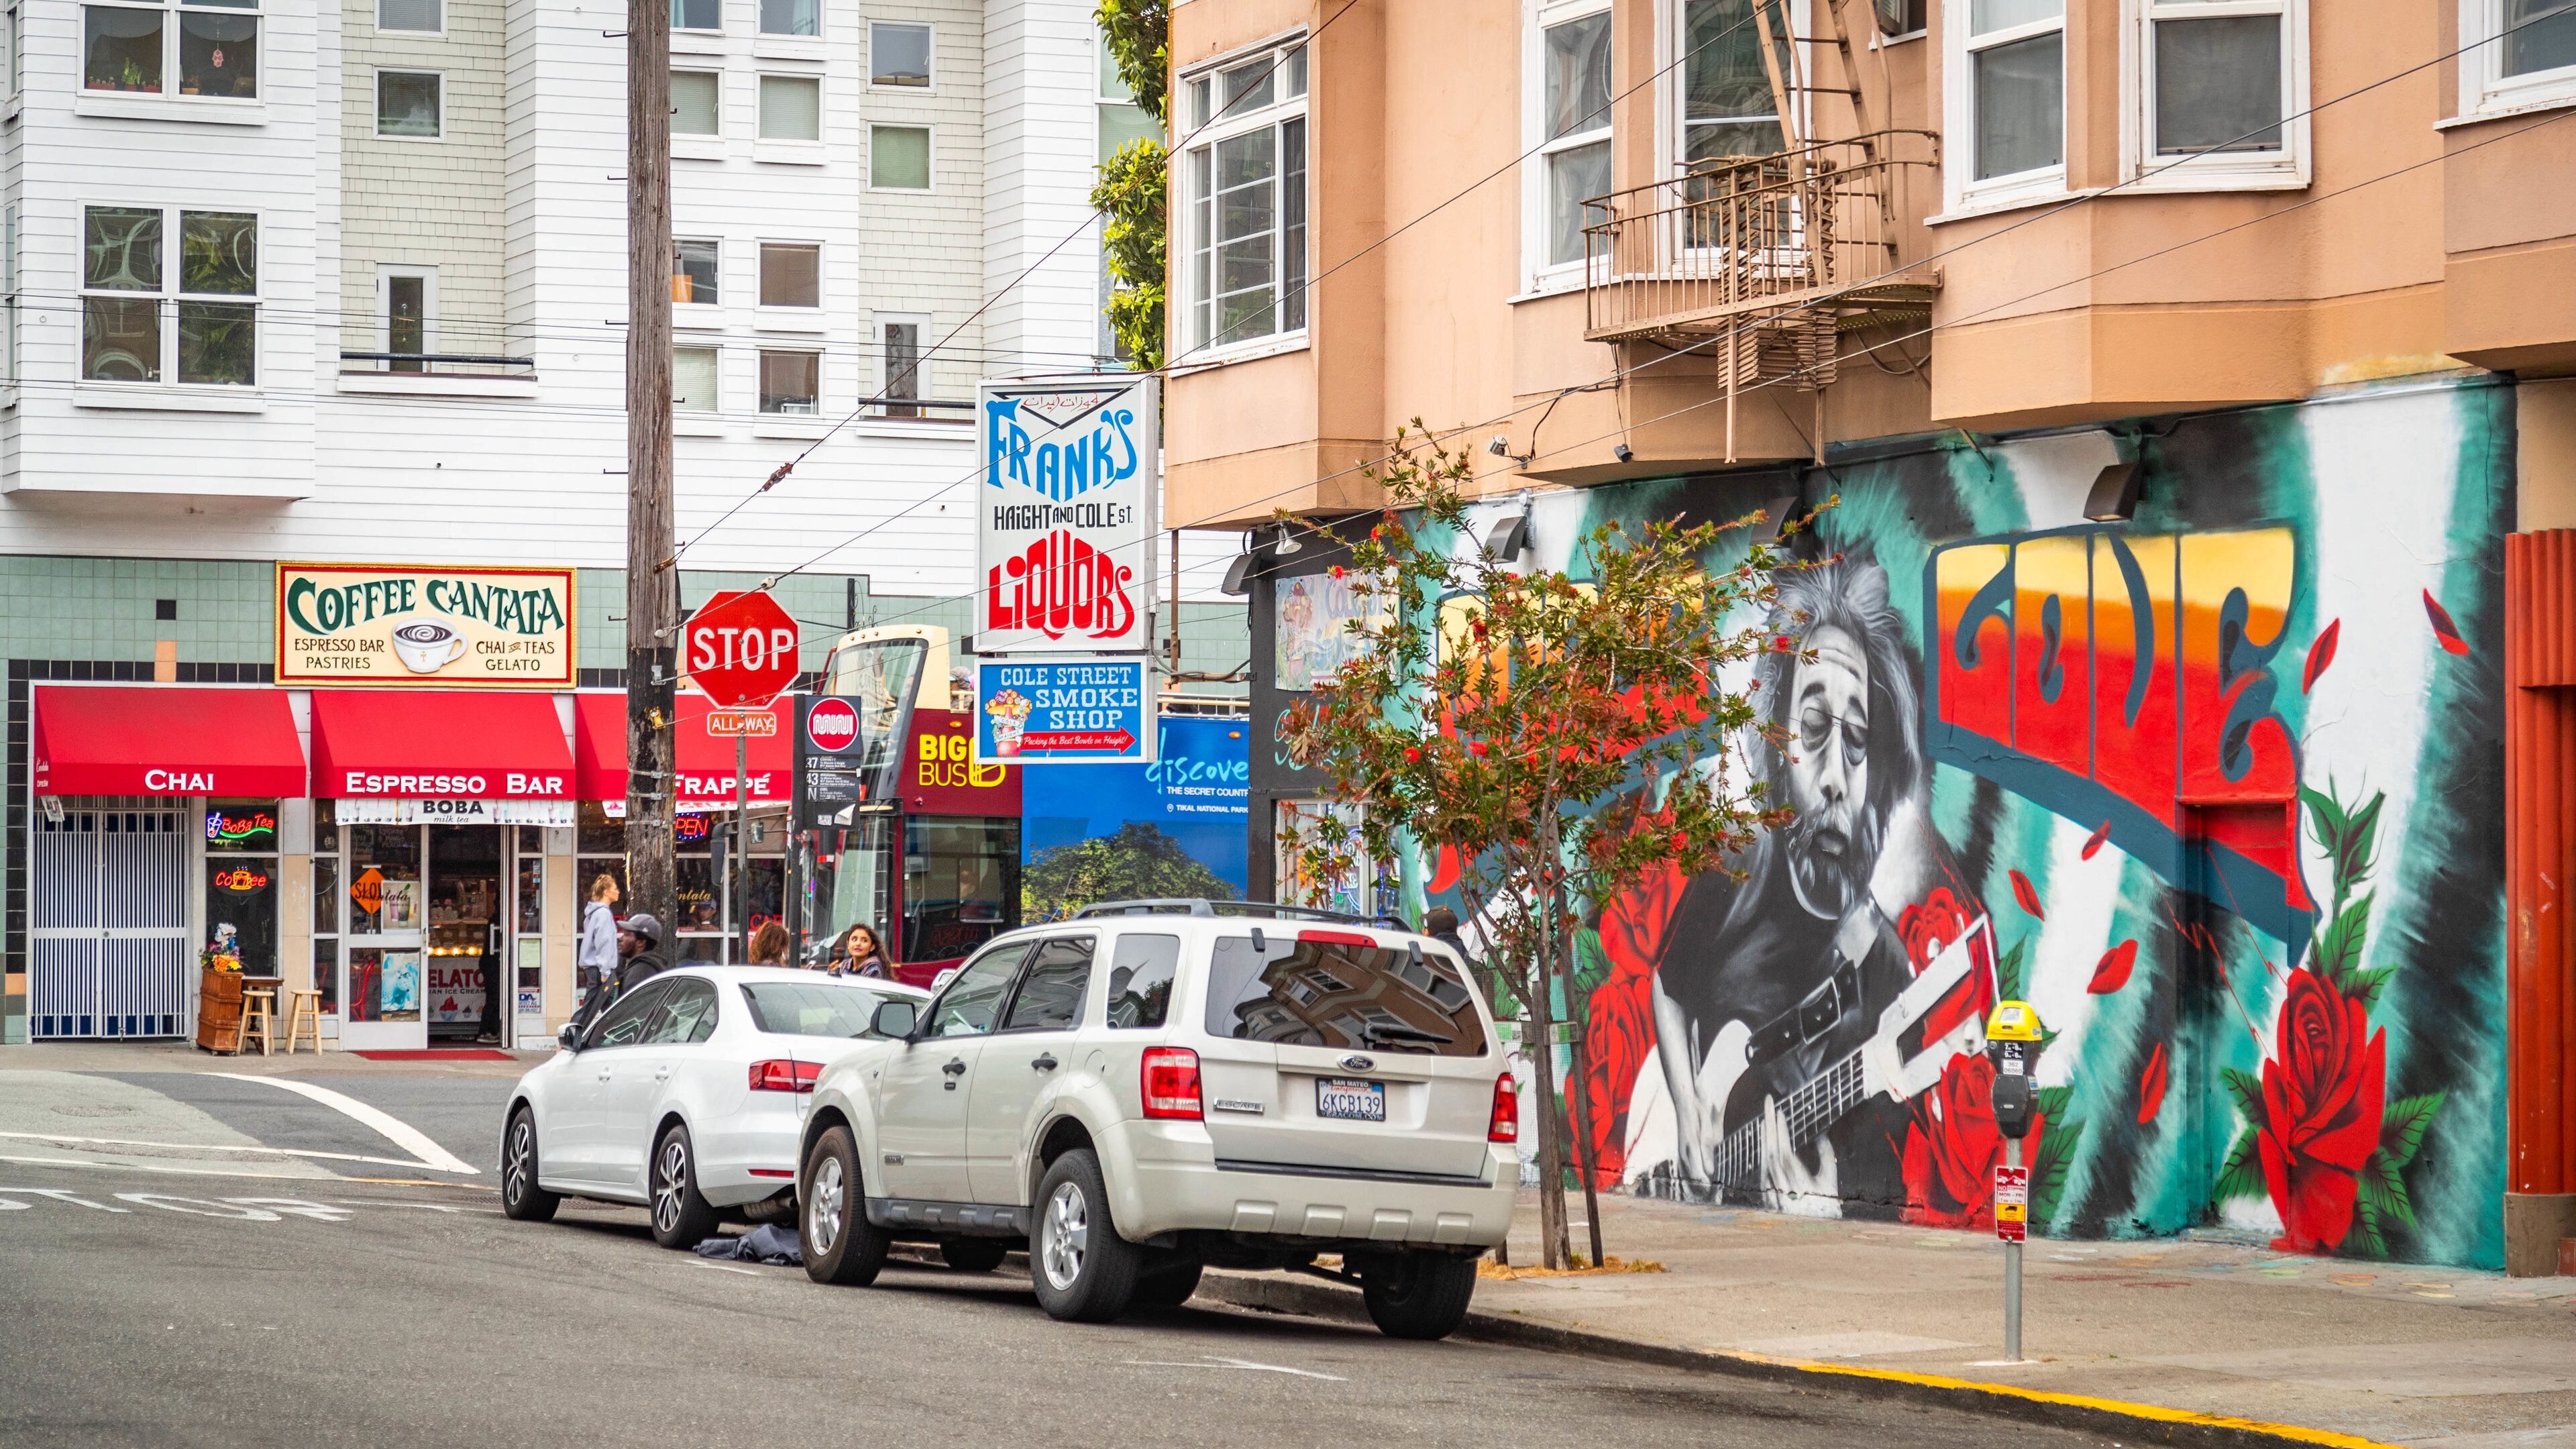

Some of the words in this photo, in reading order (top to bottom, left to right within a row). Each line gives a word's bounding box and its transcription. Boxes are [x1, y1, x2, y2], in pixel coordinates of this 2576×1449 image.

[986, 398, 1137, 503] FRANK'S
[1053, 507, 1073, 524] AND
[1075, 503, 1116, 529] COLE
[287, 577, 417, 635] COFFEE
[426, 579, 565, 635] CANTATA
[294, 638, 356, 653] ESPRESSO
[360, 639, 384, 653] BAR
[476, 641, 505, 654] CHAI
[524, 641, 555, 654] TEAS
[693, 627, 794, 671] STOP
[306, 656, 370, 669] PASTRIES
[485, 659, 540, 671] GELATO
[1001, 668, 1048, 686] COLE
[1057, 666, 1132, 686] STREET
[1036, 688, 1138, 708] SMOKE
[1050, 710, 1123, 729] SHOP
[919, 734, 967, 761] BIG
[1024, 736, 1047, 748] Packing
[1049, 736, 1057, 745] the
[1059, 735, 1073, 745] Best
[1075, 735, 1093, 745] Bowls
[1145, 727, 1249, 795] discove
[144, 769, 214, 791] CHAI
[346, 771, 487, 794] ESPRESSO
[506, 773, 564, 794] BAR
[806, 773, 818, 786] 43
[919, 762, 967, 787] BUS
[808, 787, 817, 800] N
[1166, 786, 1183, 795] THE
[1184, 786, 1216, 796] SECRET
[423, 800, 484, 814] BOBA
[1197, 805, 1229, 813] NATIONAL
[254, 812, 275, 829] Tea
[433, 814, 453, 823] milk
[675, 816, 709, 836] PEN
[677, 889, 712, 901] ntata
[429, 968, 485, 988] ELATO
[1349, 1058, 1368, 1068] Ford
[1218, 1101, 1261, 1110] ESCAPE
[1322, 1093, 1381, 1114] 6KCB139
